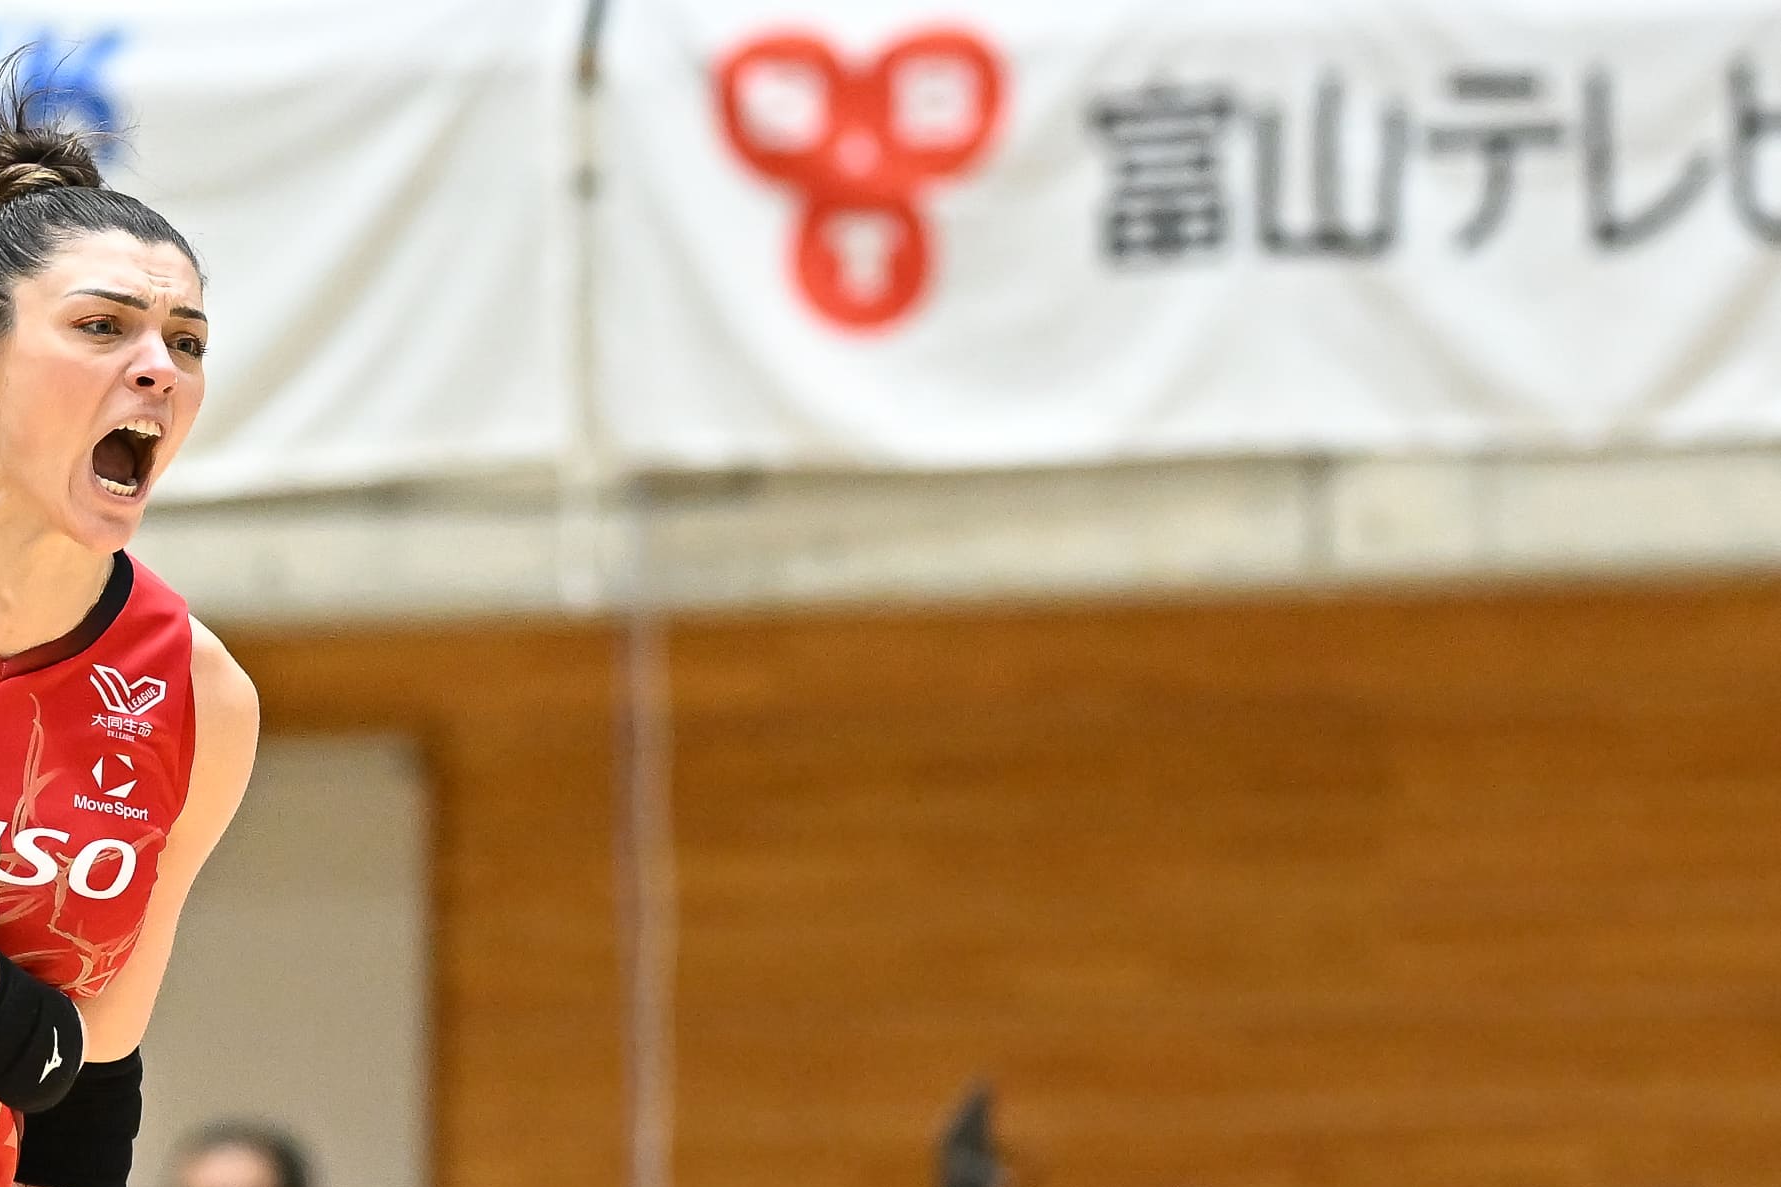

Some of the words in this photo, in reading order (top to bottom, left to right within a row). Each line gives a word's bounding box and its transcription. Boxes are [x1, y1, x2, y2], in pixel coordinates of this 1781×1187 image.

[126, 685, 159, 712] LEAGUE
[90, 713, 153, 738] 大同生命
